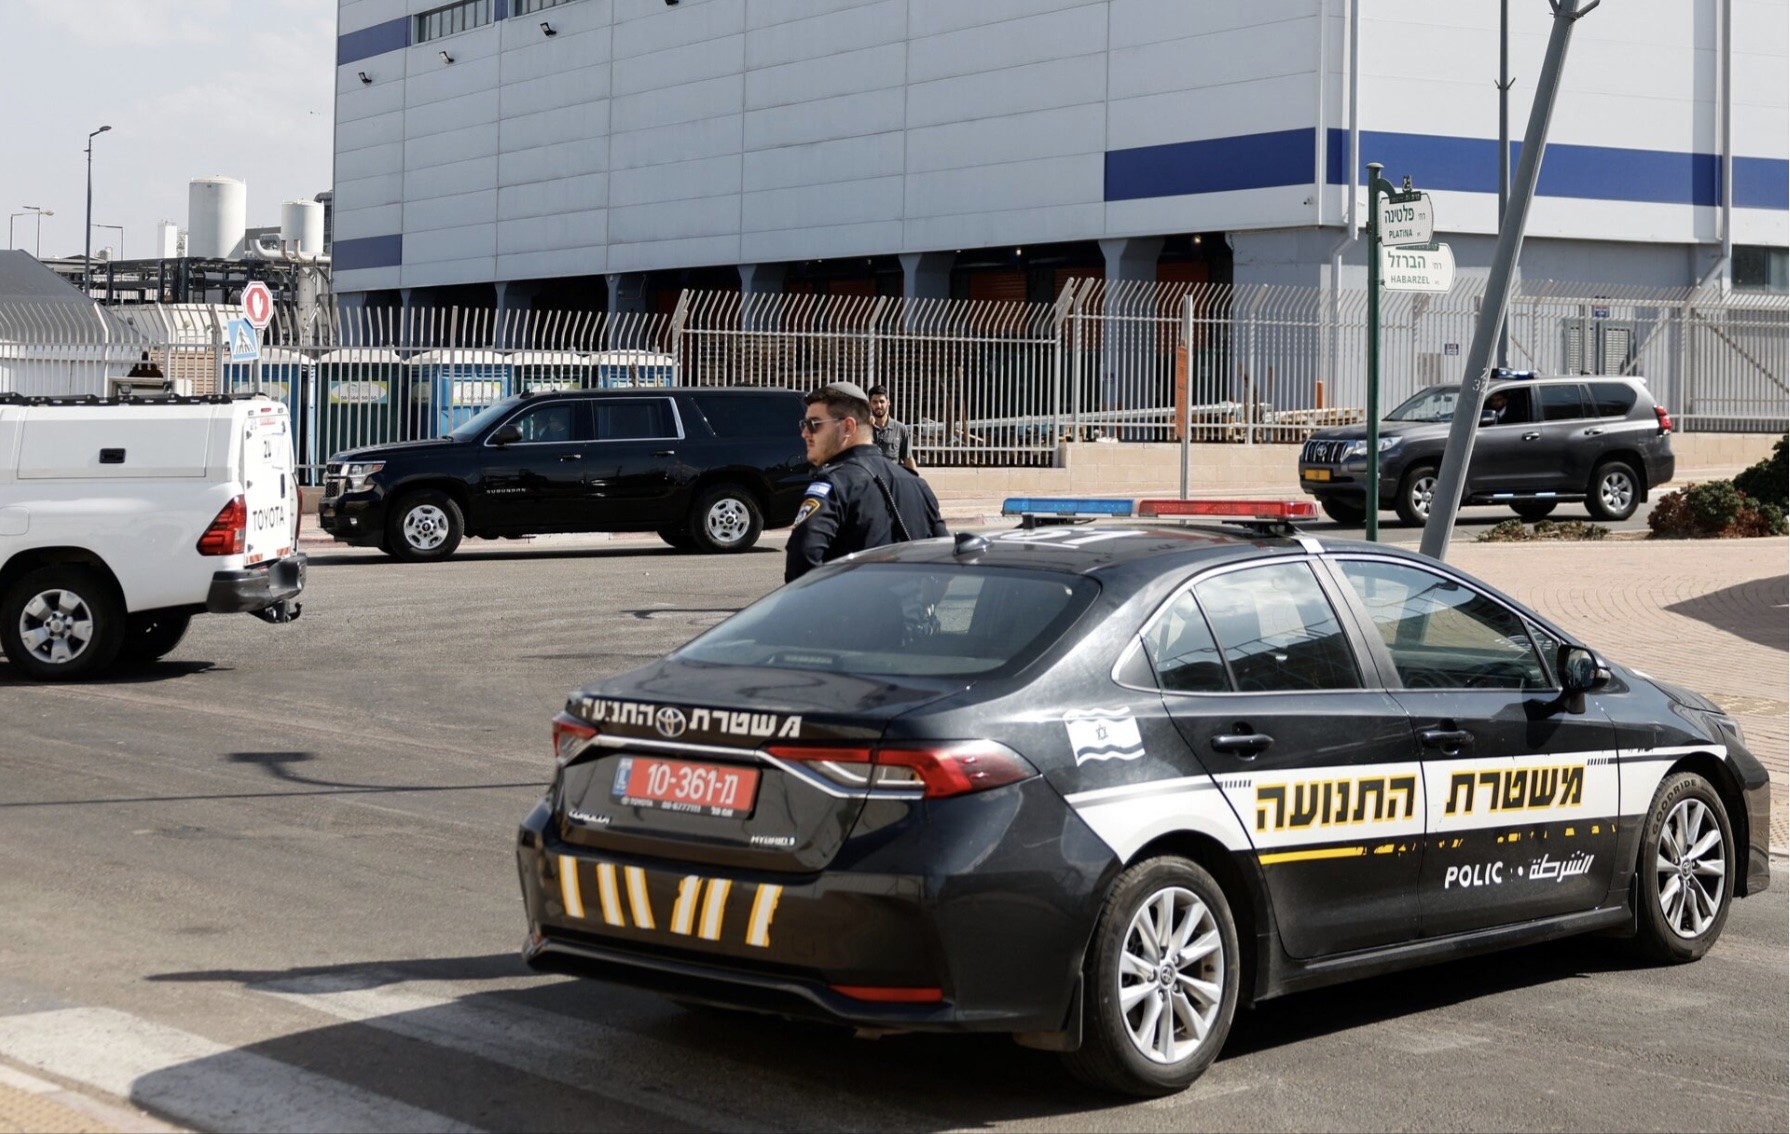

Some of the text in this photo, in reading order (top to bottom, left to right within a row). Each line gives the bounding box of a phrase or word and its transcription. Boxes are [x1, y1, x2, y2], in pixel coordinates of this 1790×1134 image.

[1384, 204, 1415, 223] פלטינה
[1389, 229, 1413, 238] PLATINA
[1388, 251, 1426, 269] הברזל
[1390, 275, 1431, 284] HABARZEL
[252, 505, 285, 531] TOYOTA
[1254, 764, 1586, 833] משטרת התנועה
[1652, 778, 1698, 836] GOODRIDE
[1529, 850, 1595, 883] الشرطة
